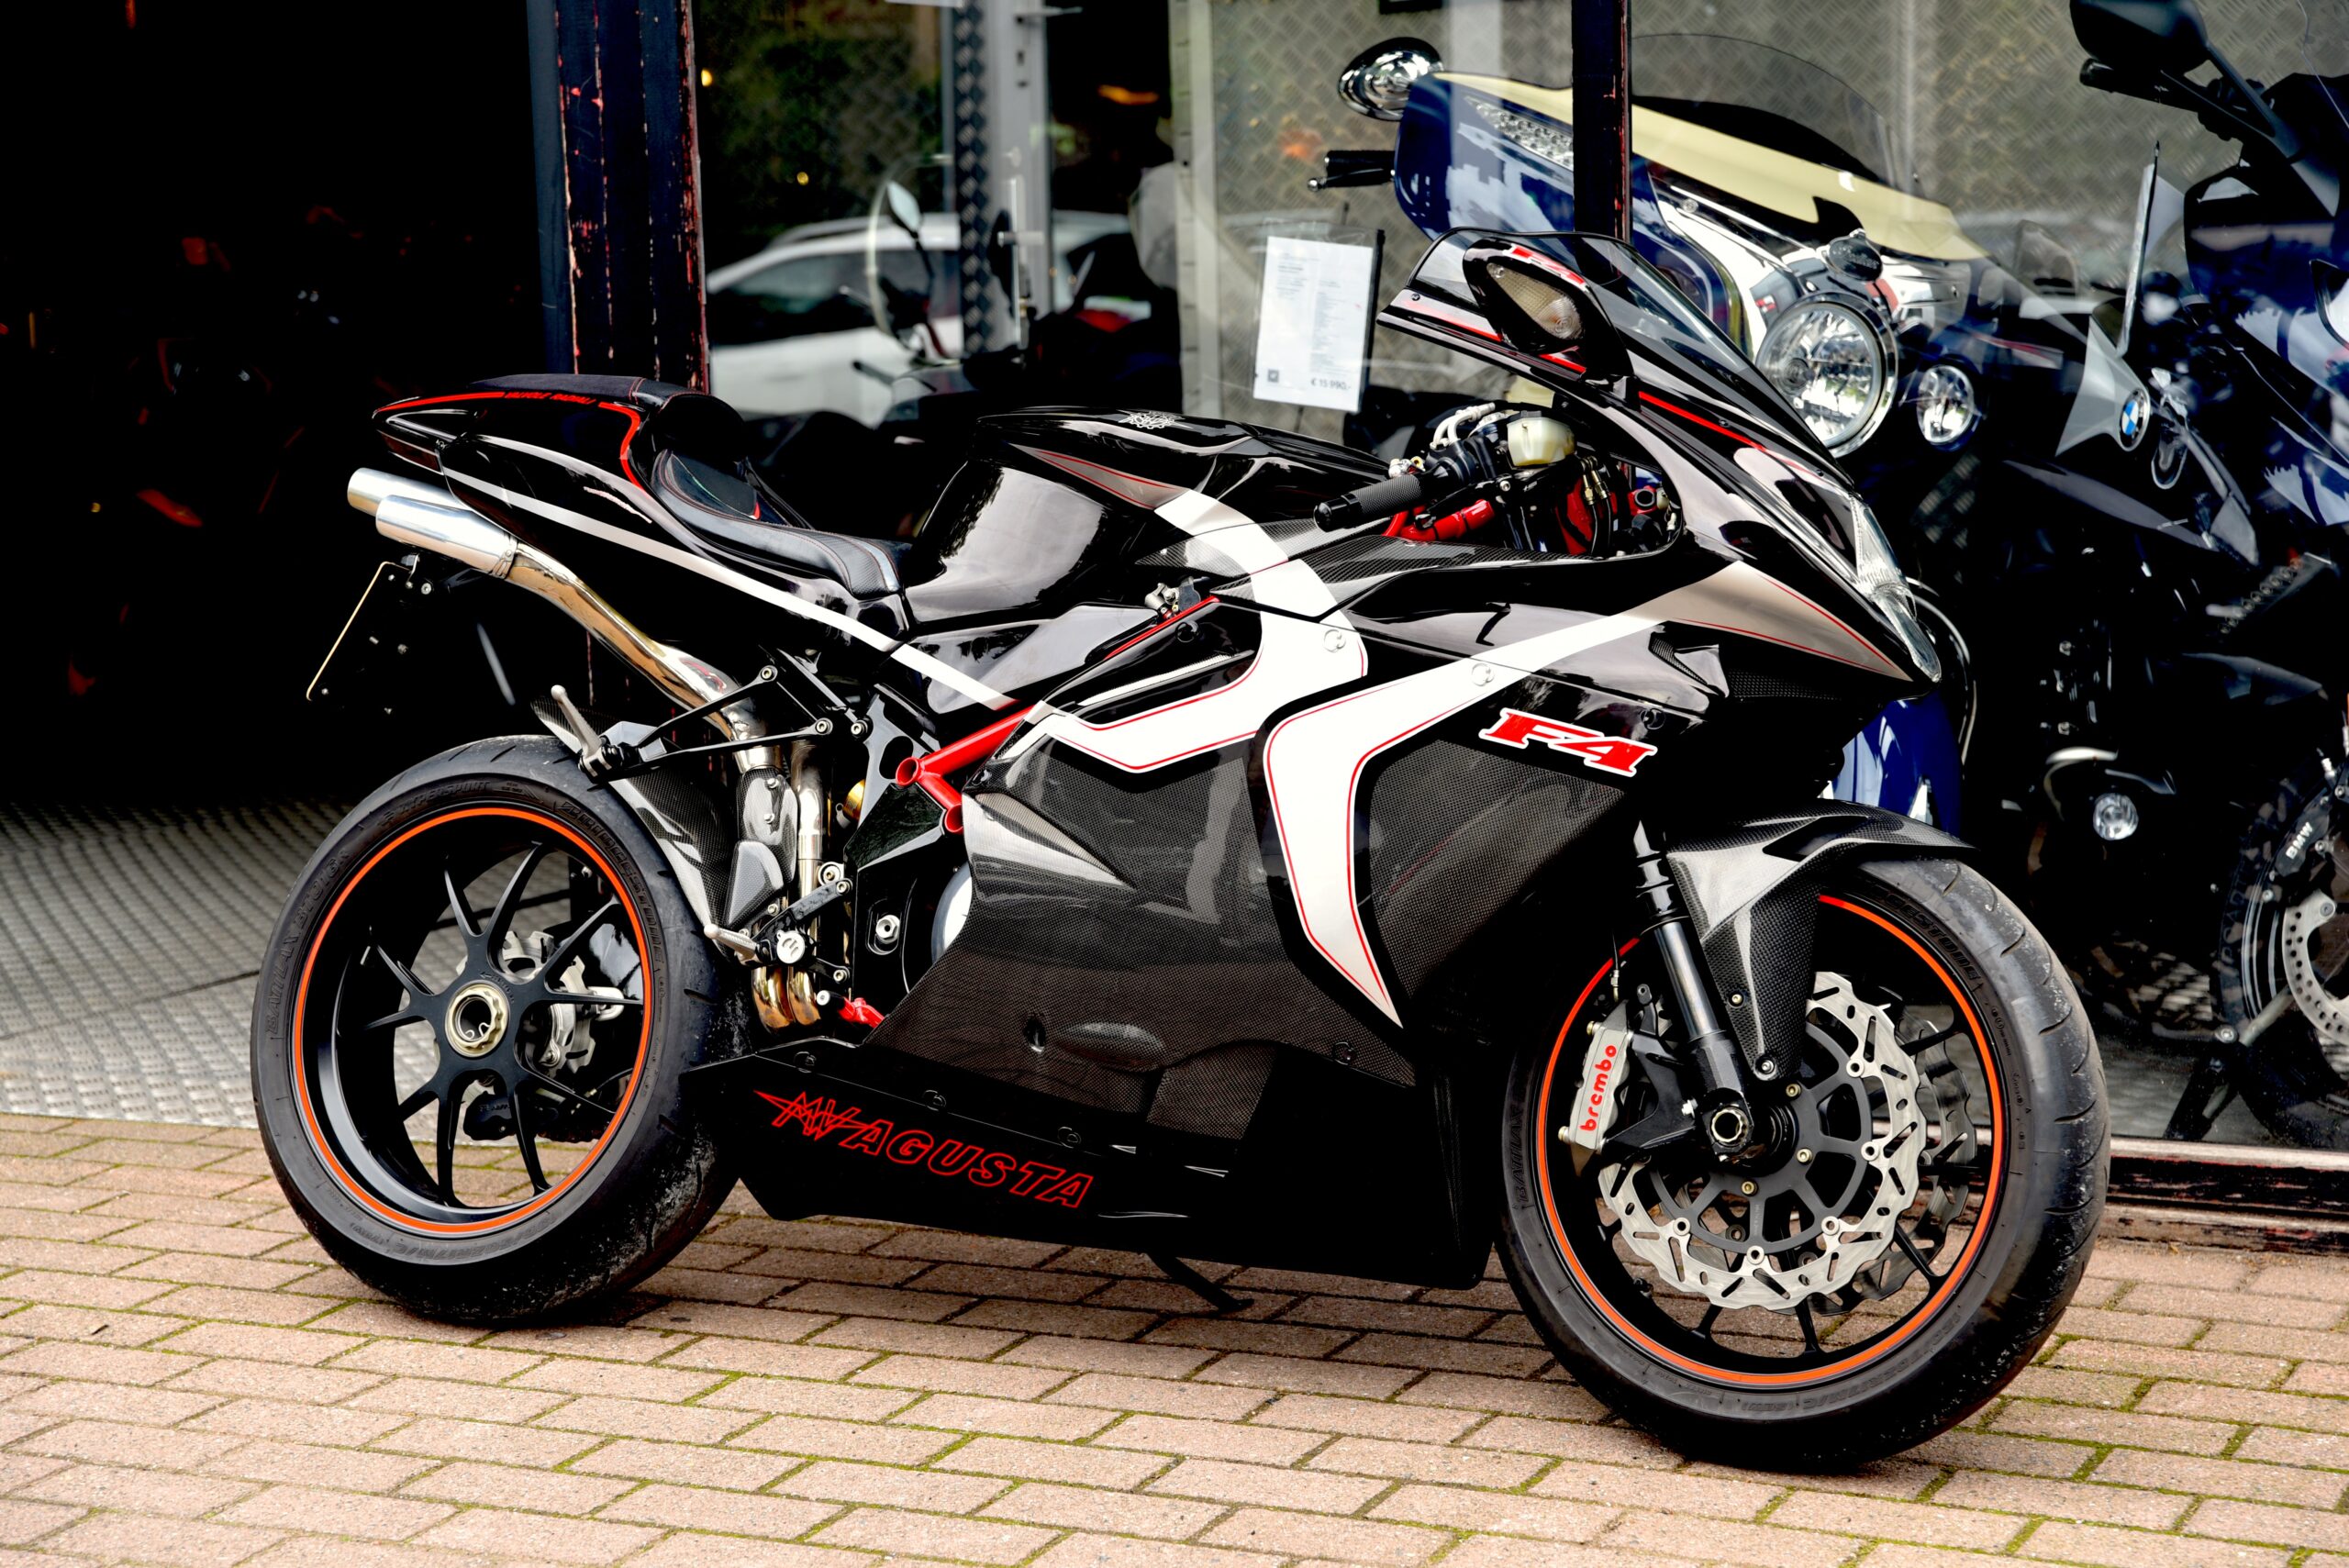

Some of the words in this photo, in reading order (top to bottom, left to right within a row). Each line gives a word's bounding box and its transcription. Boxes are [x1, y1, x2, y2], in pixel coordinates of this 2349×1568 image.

[1478, 707, 1658, 777] F4
[557, 801, 662, 962] BRIDGESTONE
[2286, 821, 2313, 860] BMW
[1580, 1045, 1617, 1131] brembo
[838, 1118, 1094, 1208] AGUSTA
